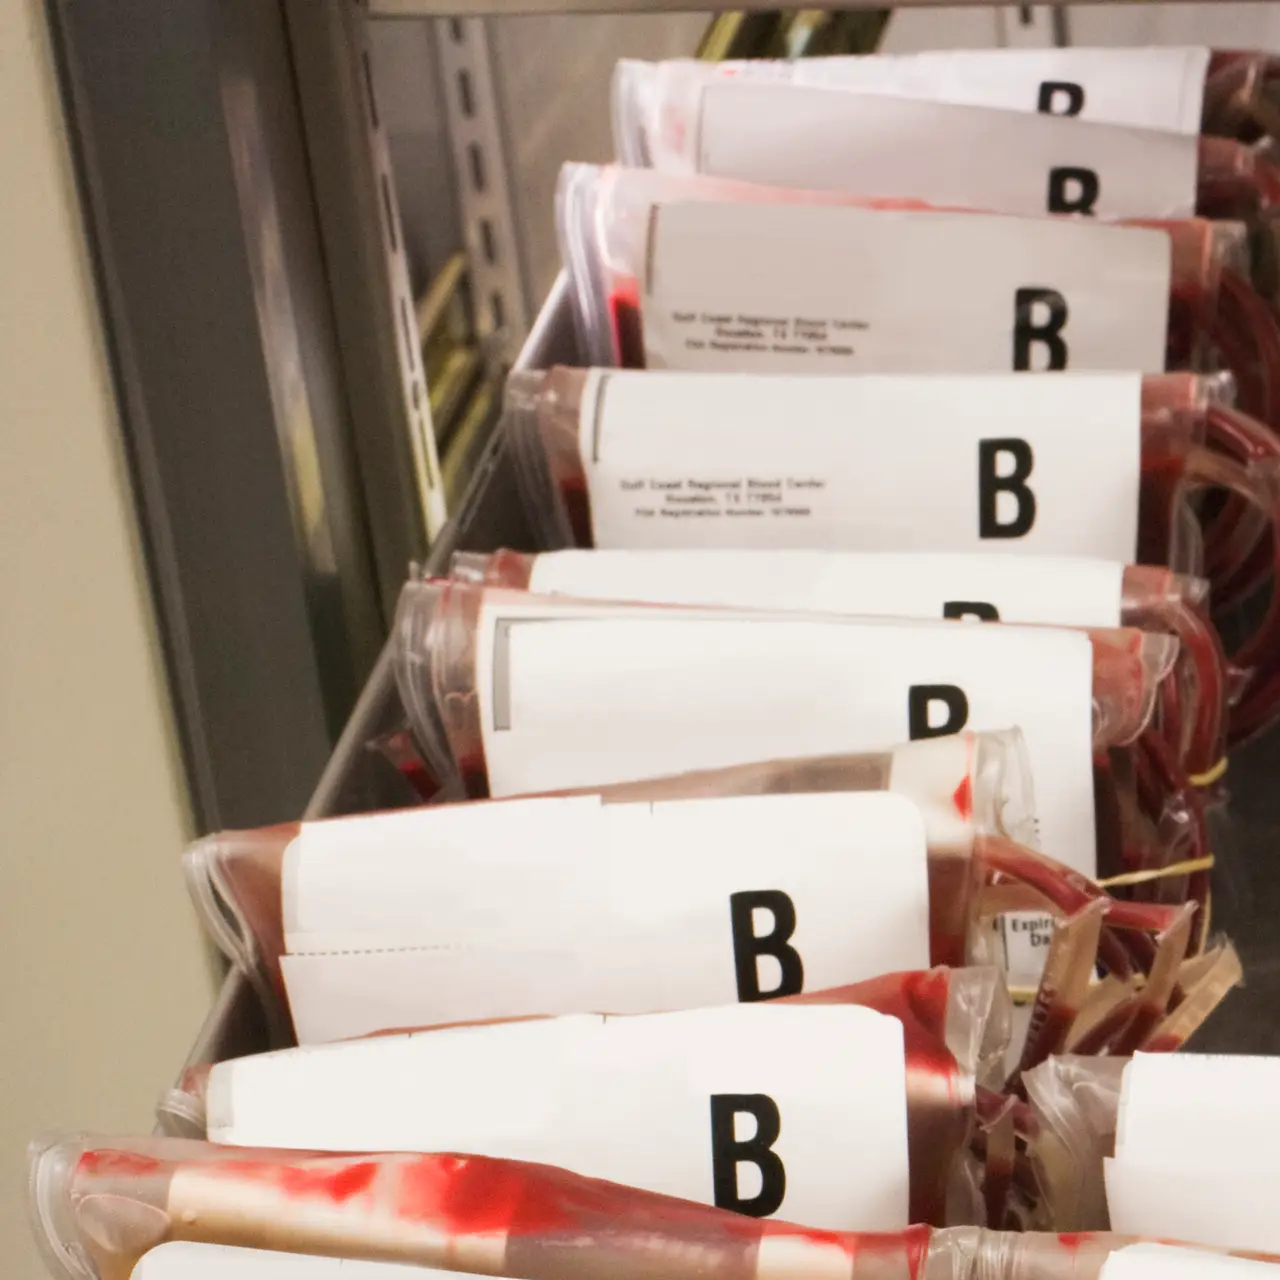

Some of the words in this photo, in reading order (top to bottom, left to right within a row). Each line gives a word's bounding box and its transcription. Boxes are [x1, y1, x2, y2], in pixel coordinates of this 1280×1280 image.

[1014, 288, 1067, 371] B
[979, 439, 1036, 539] B
[731, 890, 803, 1002] B
[710, 1093, 786, 1217] B
